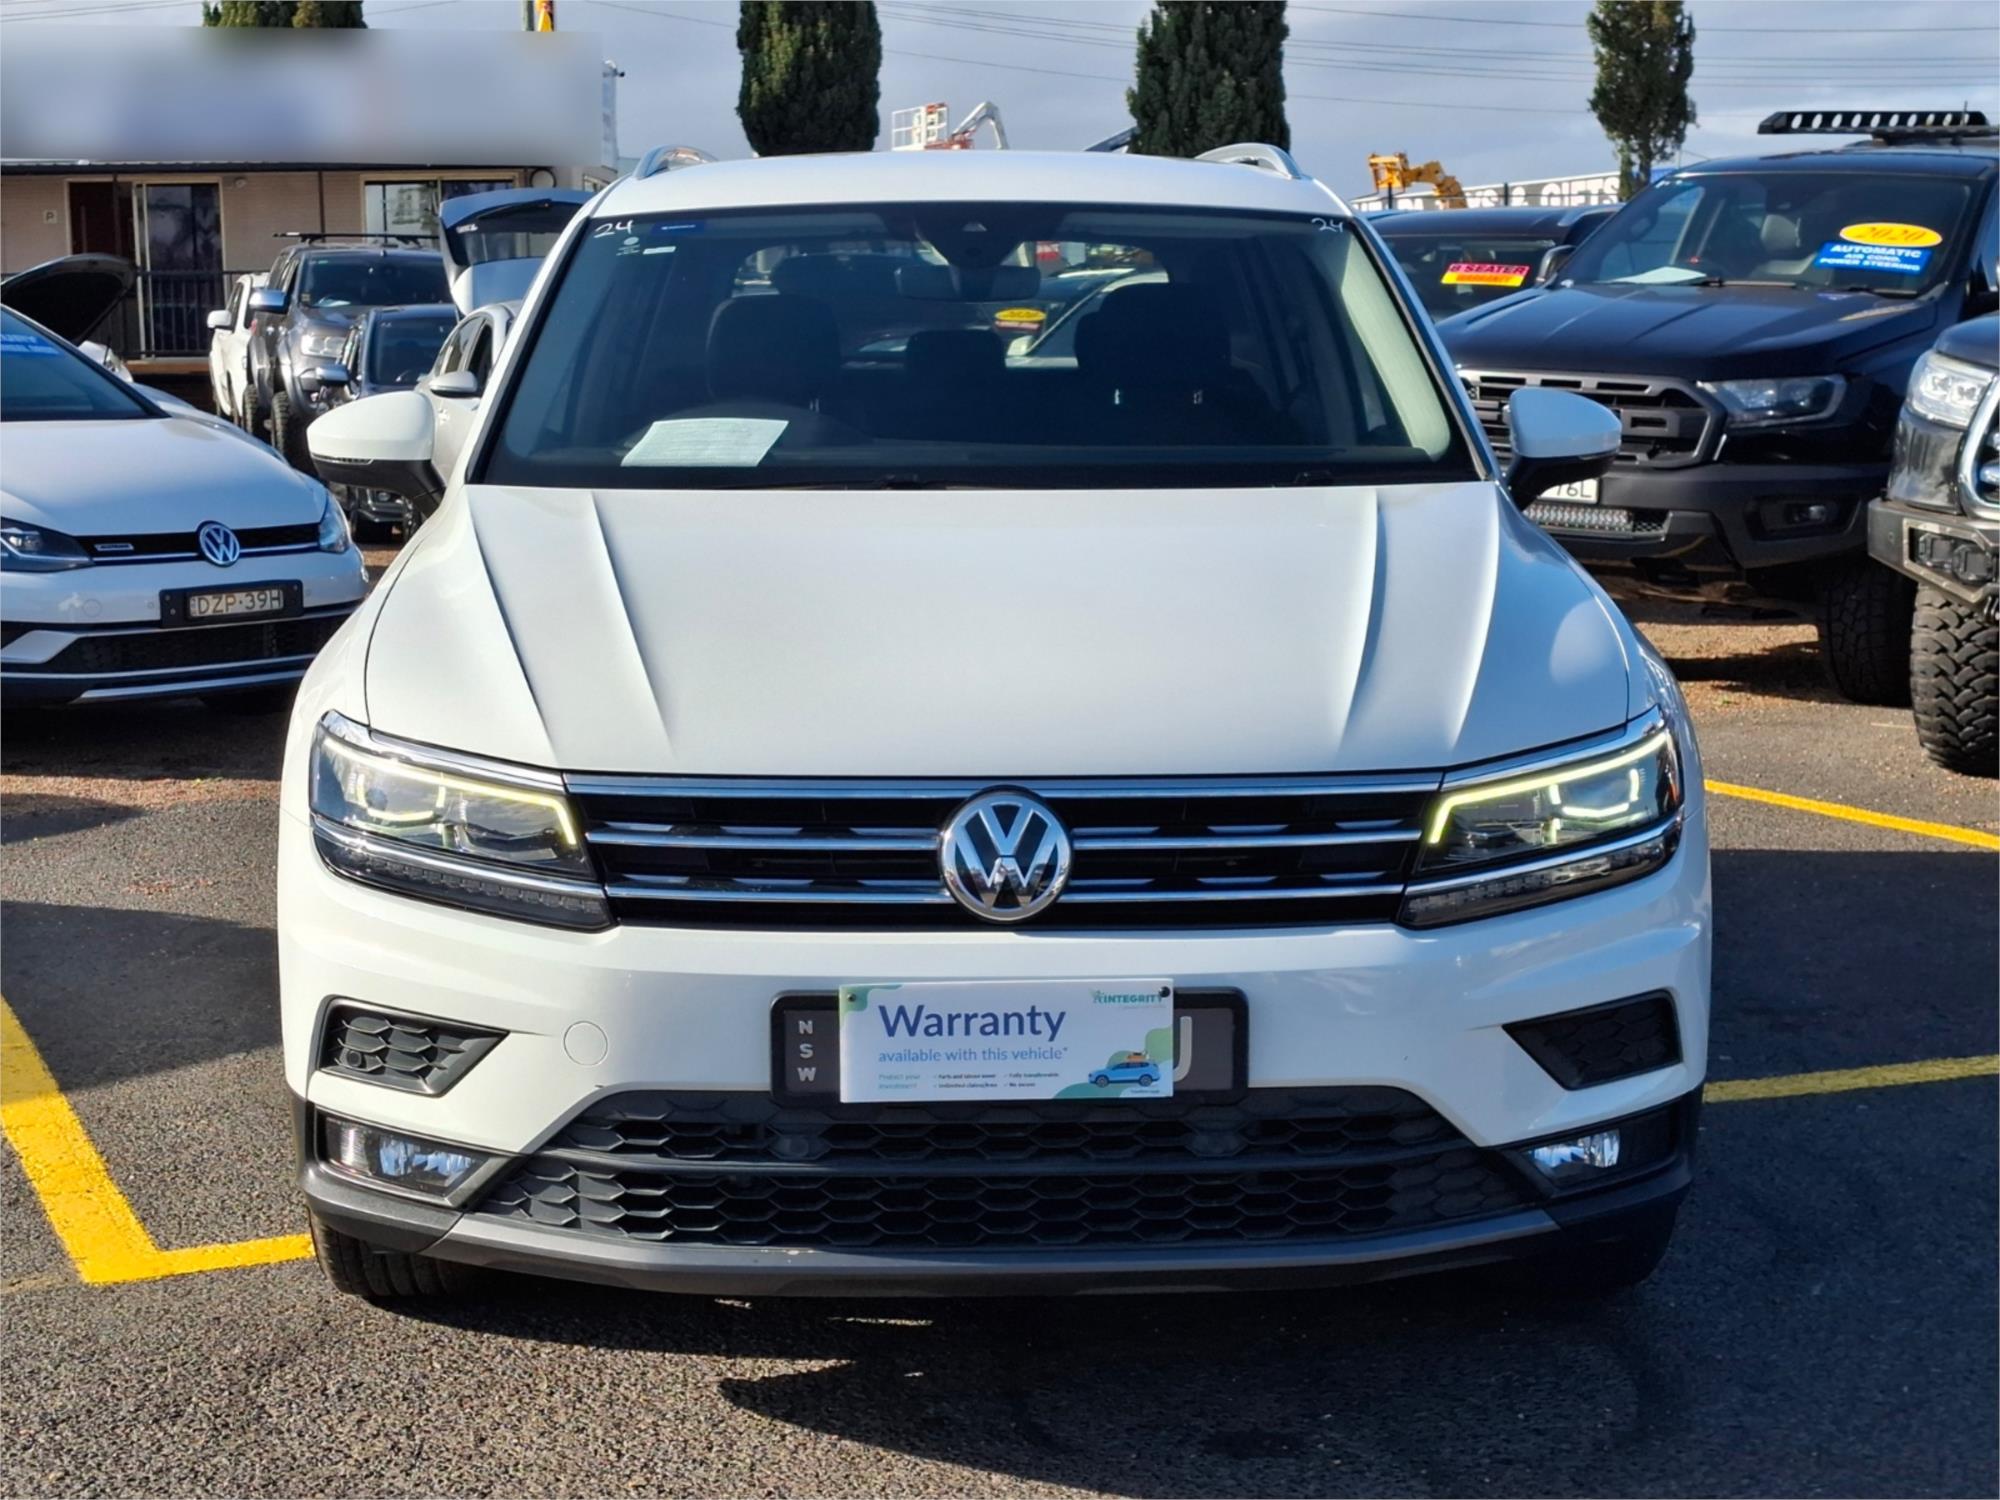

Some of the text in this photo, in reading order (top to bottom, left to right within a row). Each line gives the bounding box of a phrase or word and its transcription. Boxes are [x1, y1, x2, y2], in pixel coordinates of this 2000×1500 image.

[1540, 176, 1621, 207] GIFTS
[593, 219, 634, 238] 24
[1311, 217, 1344, 233] 24
[1830, 244, 1922, 258] AUTOMATIC
[878, 1004, 1066, 1042] Warranty
[878, 1048, 941, 1063] available
[945, 1048, 977, 1061] with
[982, 1047, 1008, 1061] this
